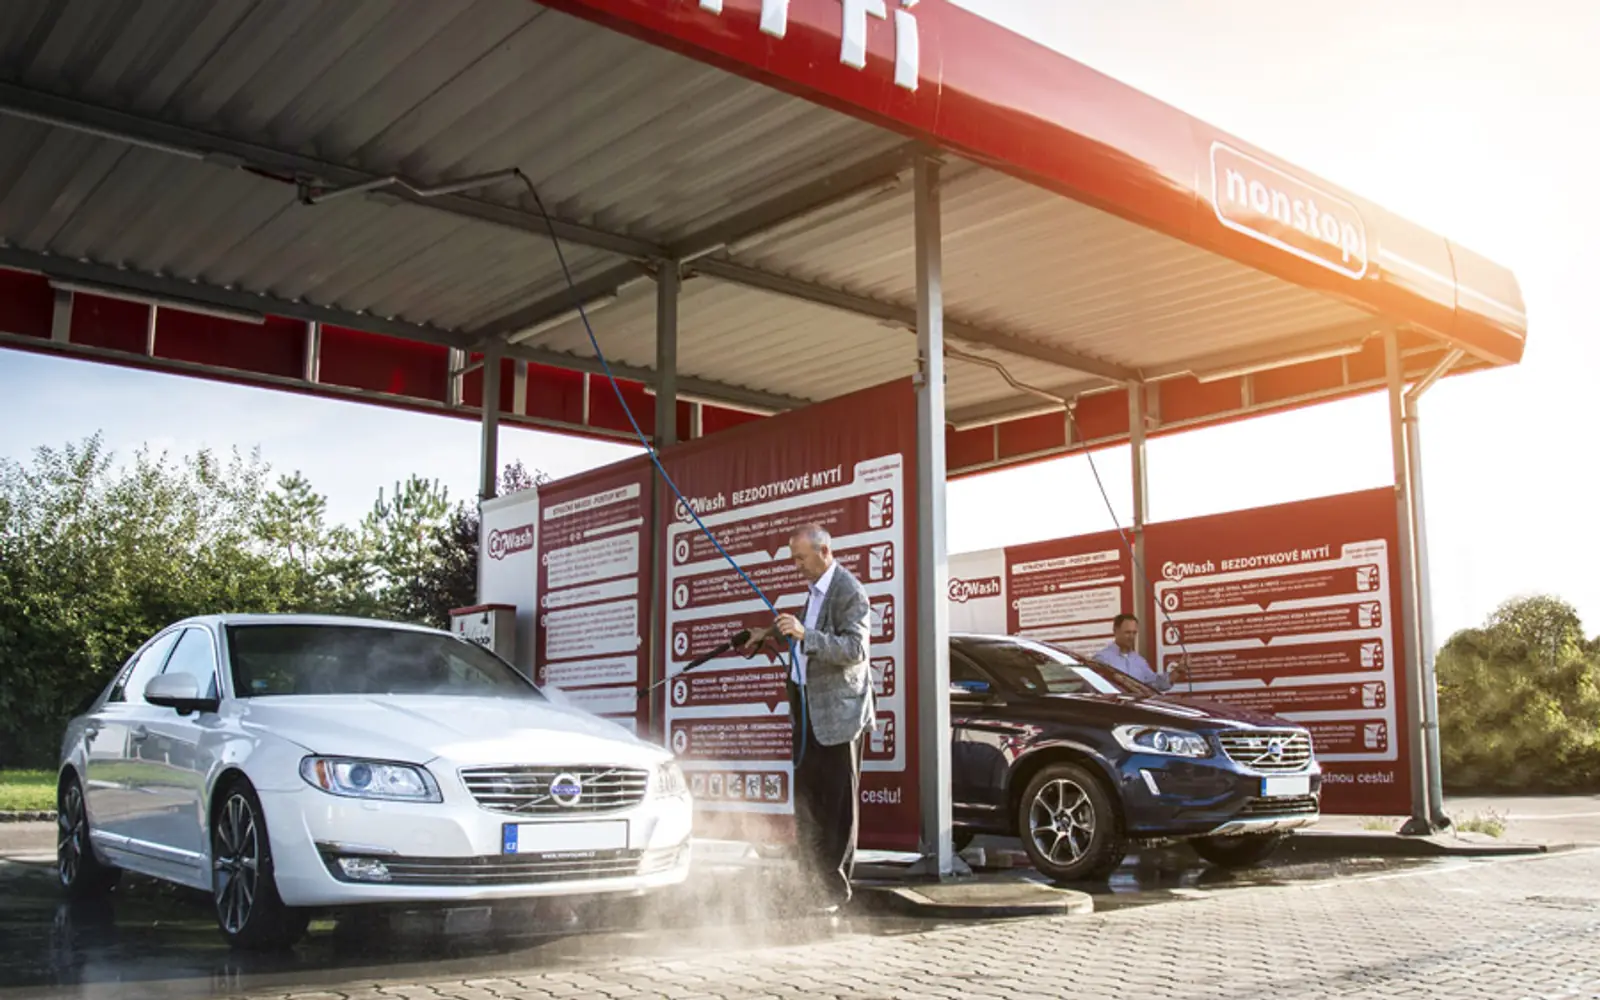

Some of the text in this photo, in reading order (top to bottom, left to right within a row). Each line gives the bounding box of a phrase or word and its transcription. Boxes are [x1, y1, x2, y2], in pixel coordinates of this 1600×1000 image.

[1225, 167, 1360, 263] nonstop
[732, 472, 810, 506] BEZDOTYKOVÉ
[812, 464, 842, 487] MYTÍ
[1161, 560, 1215, 581] CarWash
[1221, 549, 1299, 571] BEZDOTYKOVÉ
[1301, 544, 1330, 560] MYTÍ
[949, 578, 998, 601] CarWash
[1321, 771, 1394, 783] stnou cestu!
[860, 787, 901, 804] cestu!
